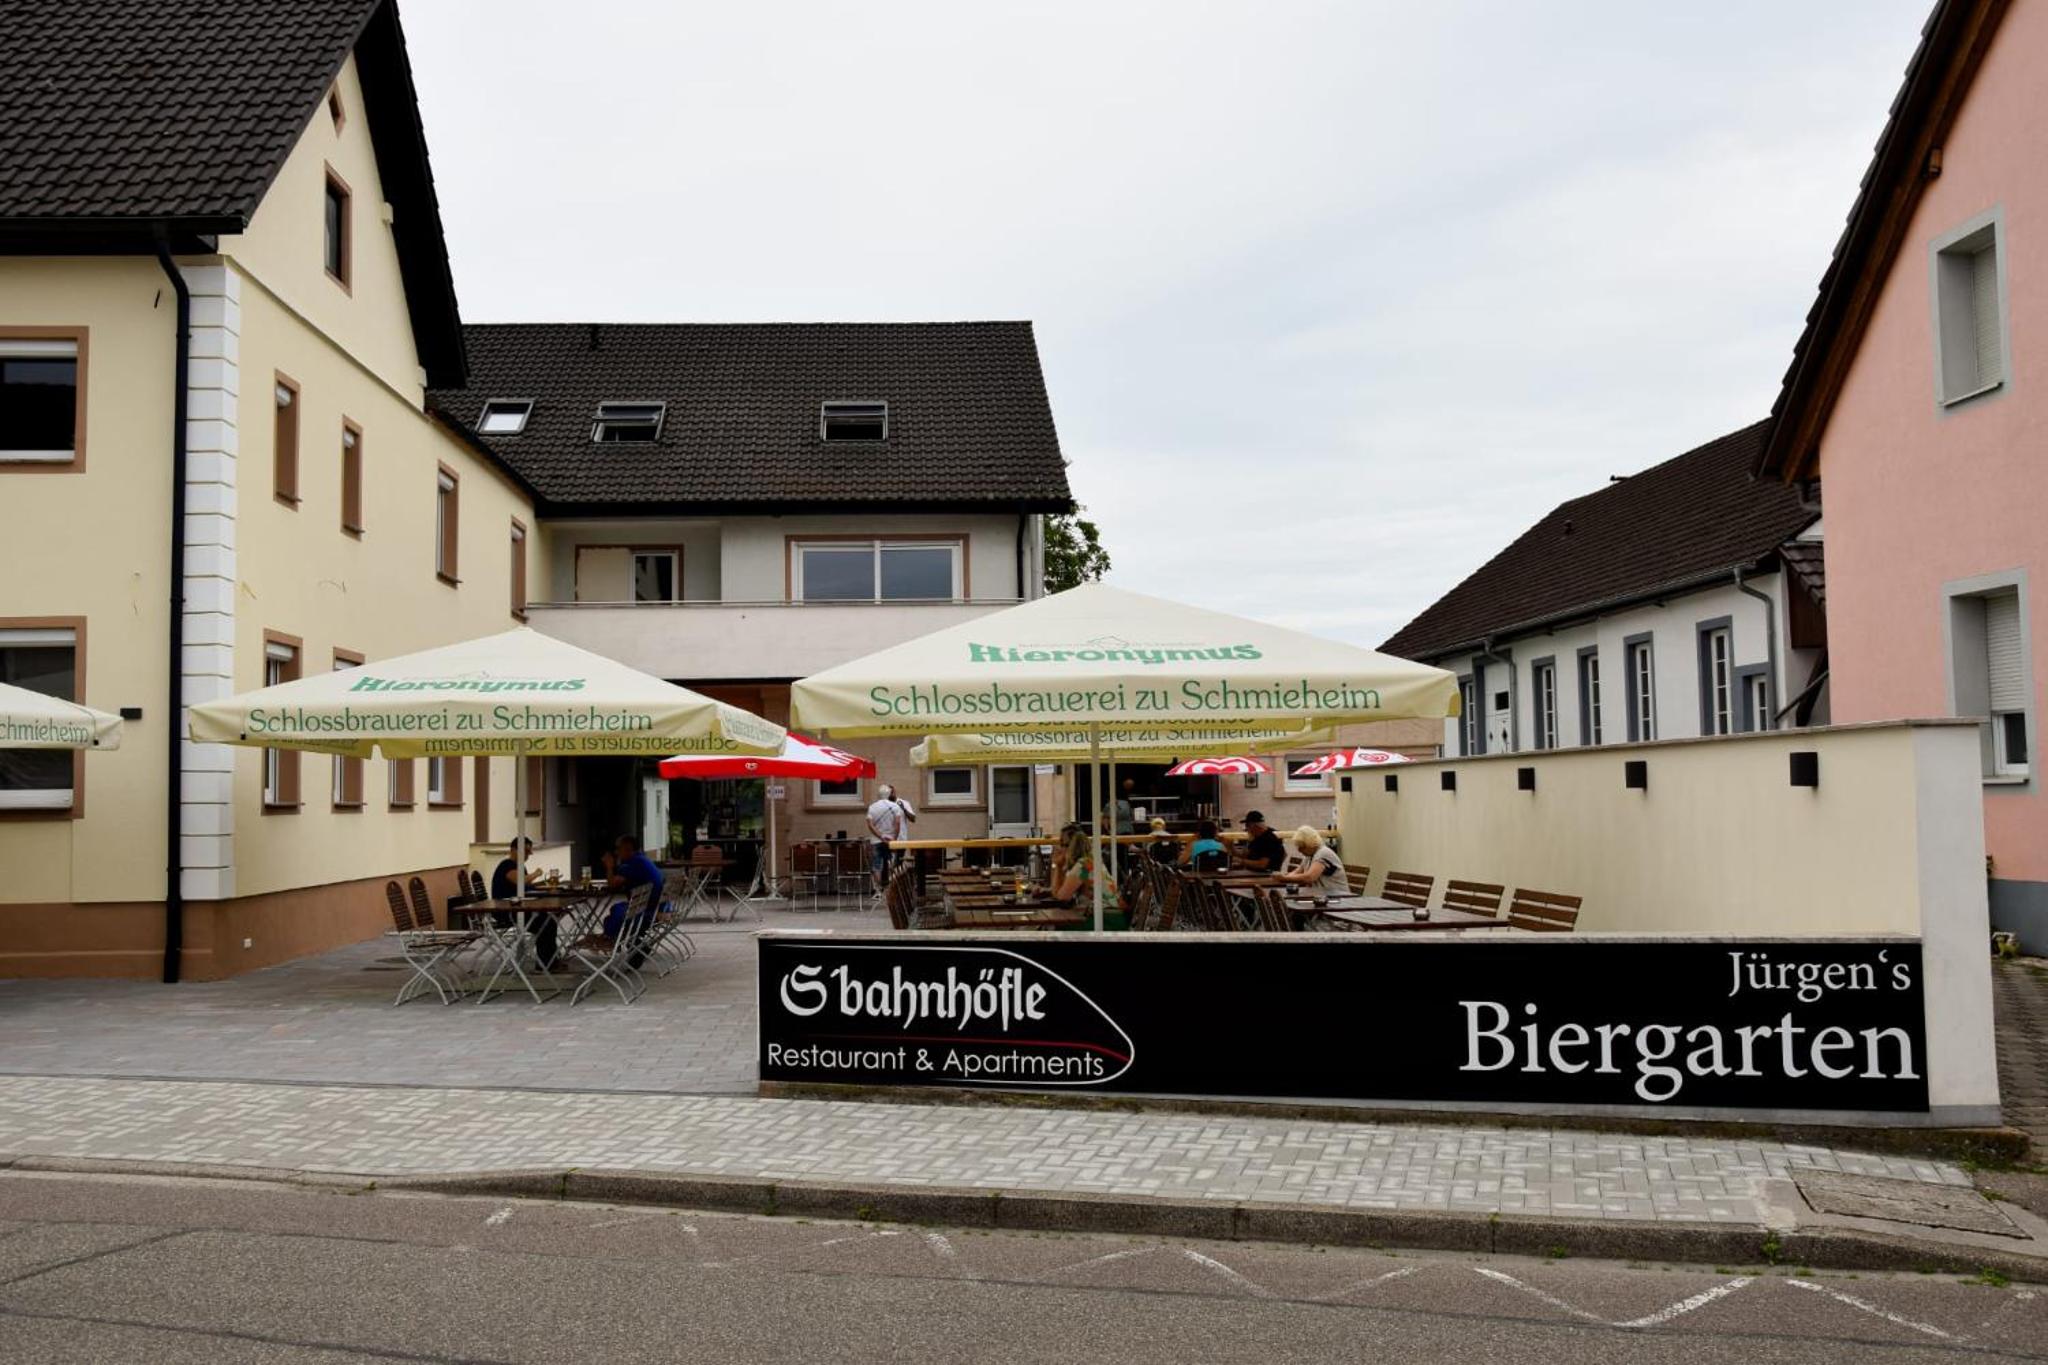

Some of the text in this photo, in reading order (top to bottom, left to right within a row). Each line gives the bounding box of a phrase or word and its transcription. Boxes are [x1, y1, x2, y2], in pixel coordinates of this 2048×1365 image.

[968, 642, 1263, 664] Hieronymus
[350, 676, 587, 693] Hieronymus
[870, 680, 1381, 716] Schlossbrauerei zu Schmieheim
[0, 714, 89, 743] chmieheim
[249, 704, 653, 733] Schlossbrauerei zu Schmieheim
[767, 1043, 1105, 1077] Restaurant & Apartments
[1458, 1000, 1921, 1101] Biergarten
